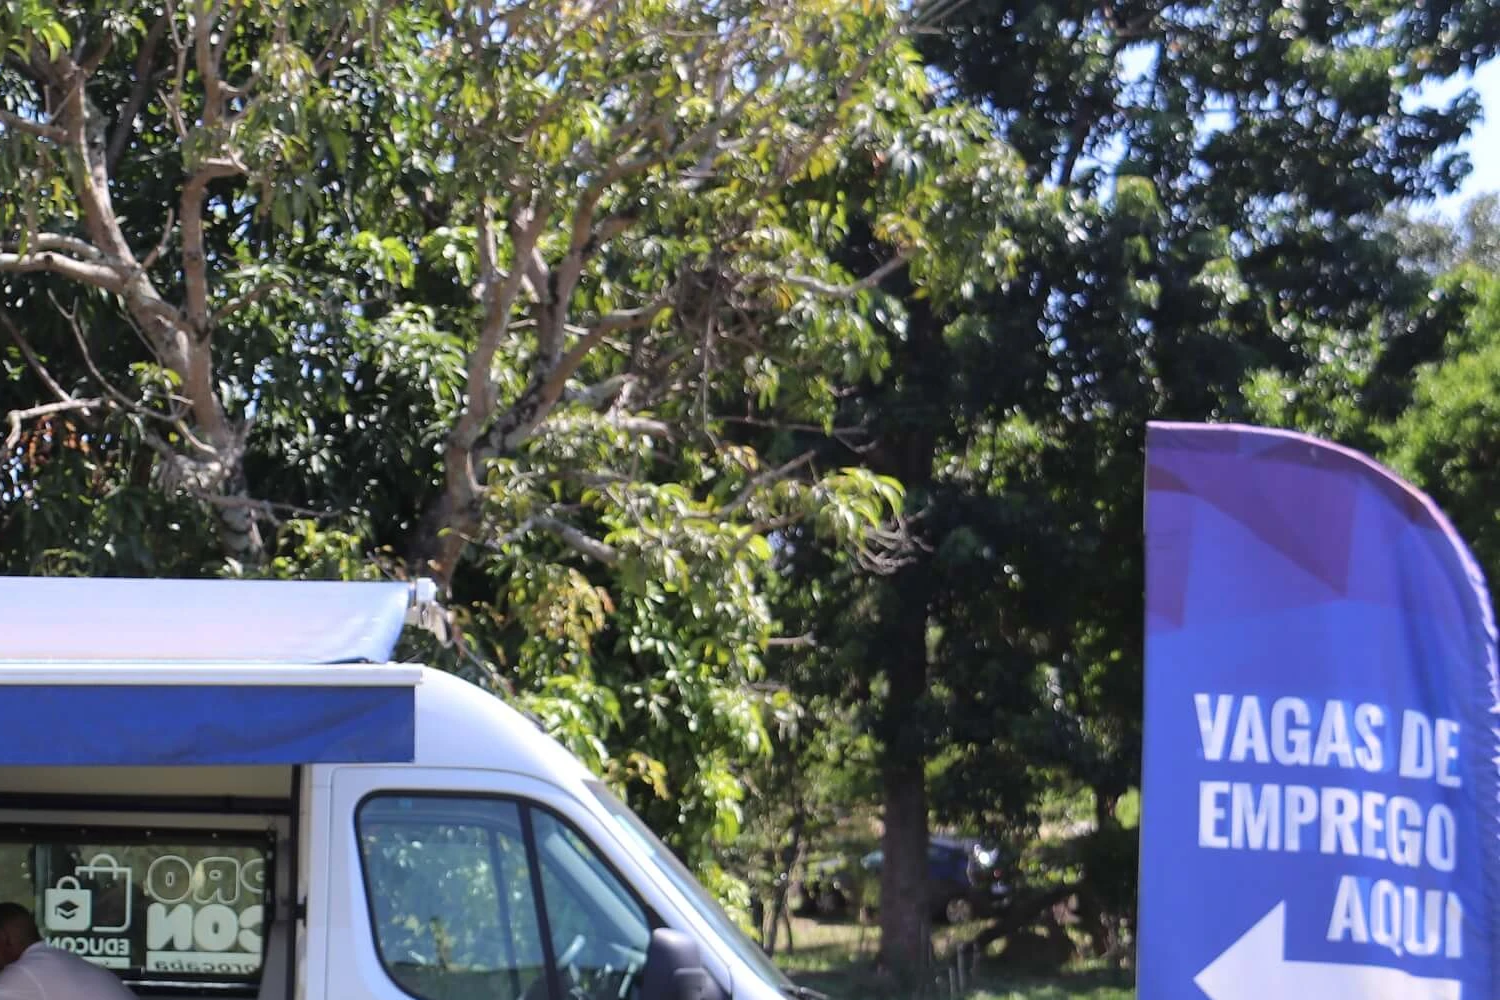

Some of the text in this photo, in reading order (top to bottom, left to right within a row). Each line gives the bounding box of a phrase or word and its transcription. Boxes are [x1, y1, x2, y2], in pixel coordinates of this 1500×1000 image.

[1193, 692, 1461, 788] VAGAS DE
[1198, 780, 1456, 872] EMPREGO
[1326, 875, 1462, 958] AQUI
